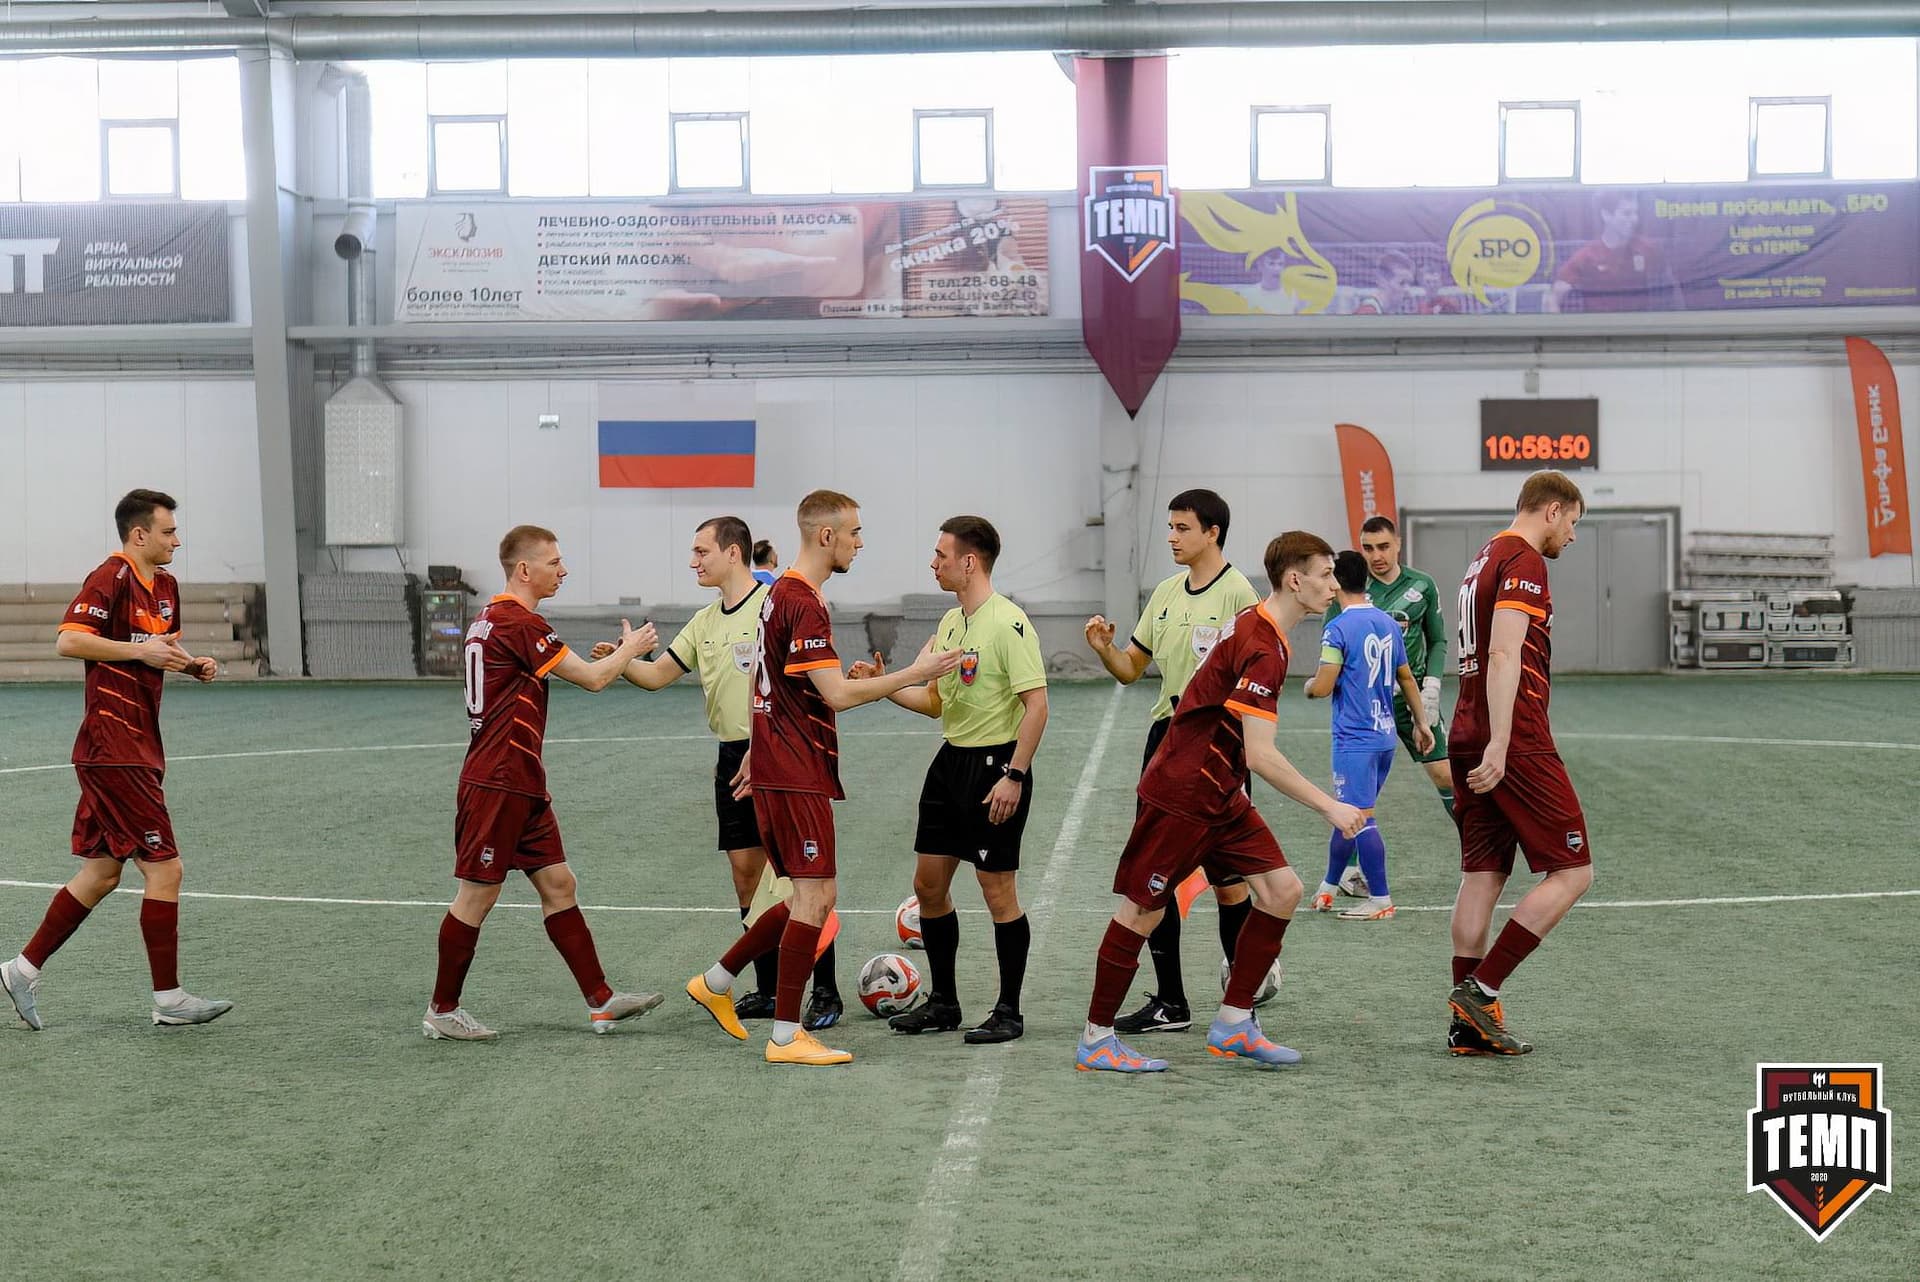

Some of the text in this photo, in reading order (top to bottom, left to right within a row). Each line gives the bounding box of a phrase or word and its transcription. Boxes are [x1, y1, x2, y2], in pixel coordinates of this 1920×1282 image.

[538, 212, 776, 228] ЛЕЧЕБНО-ОЗДОРОВИТЕЛЬНЫЙ
[1094, 198, 1166, 238] ТЕМП
[84, 242, 128, 255] АРЕНА
[428, 248, 504, 258] ЭКСКЛЮЗИВ
[84, 254, 183, 271] ВИРТУАЛЬНОЙ
[538, 252, 611, 267] ДЕТСКИЙ
[85, 272, 176, 287] РЕАЛЬНОСТИ
[407, 286, 522, 302] более 10лет
[1519, 580, 1542, 595] ПСБ
[804, 638, 827, 649] ПСБ
[1364, 632, 1393, 689] 91
